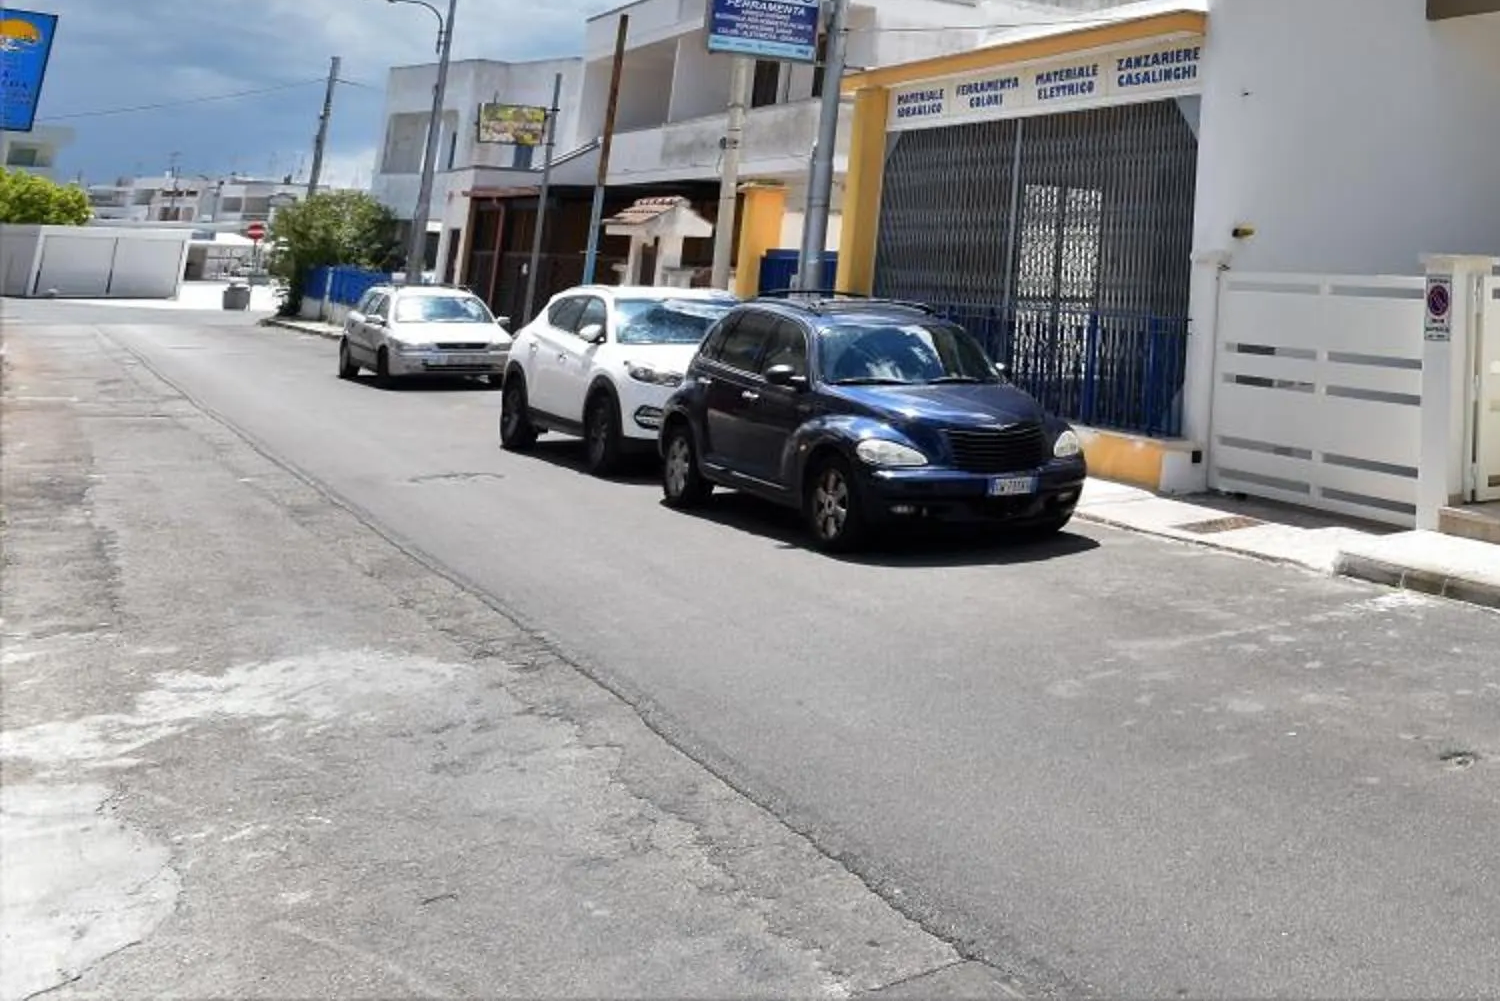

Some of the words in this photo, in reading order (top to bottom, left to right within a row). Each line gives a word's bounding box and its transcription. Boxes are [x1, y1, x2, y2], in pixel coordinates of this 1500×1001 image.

[1117, 46, 1201, 72] ZANZARIERE
[956, 76, 1019, 96] FERRAMENTA
[1035, 64, 1099, 86] MATERIALE
[1117, 65, 1198, 88] CASALINGHI
[1037, 81, 1095, 101] ELETTRICO
